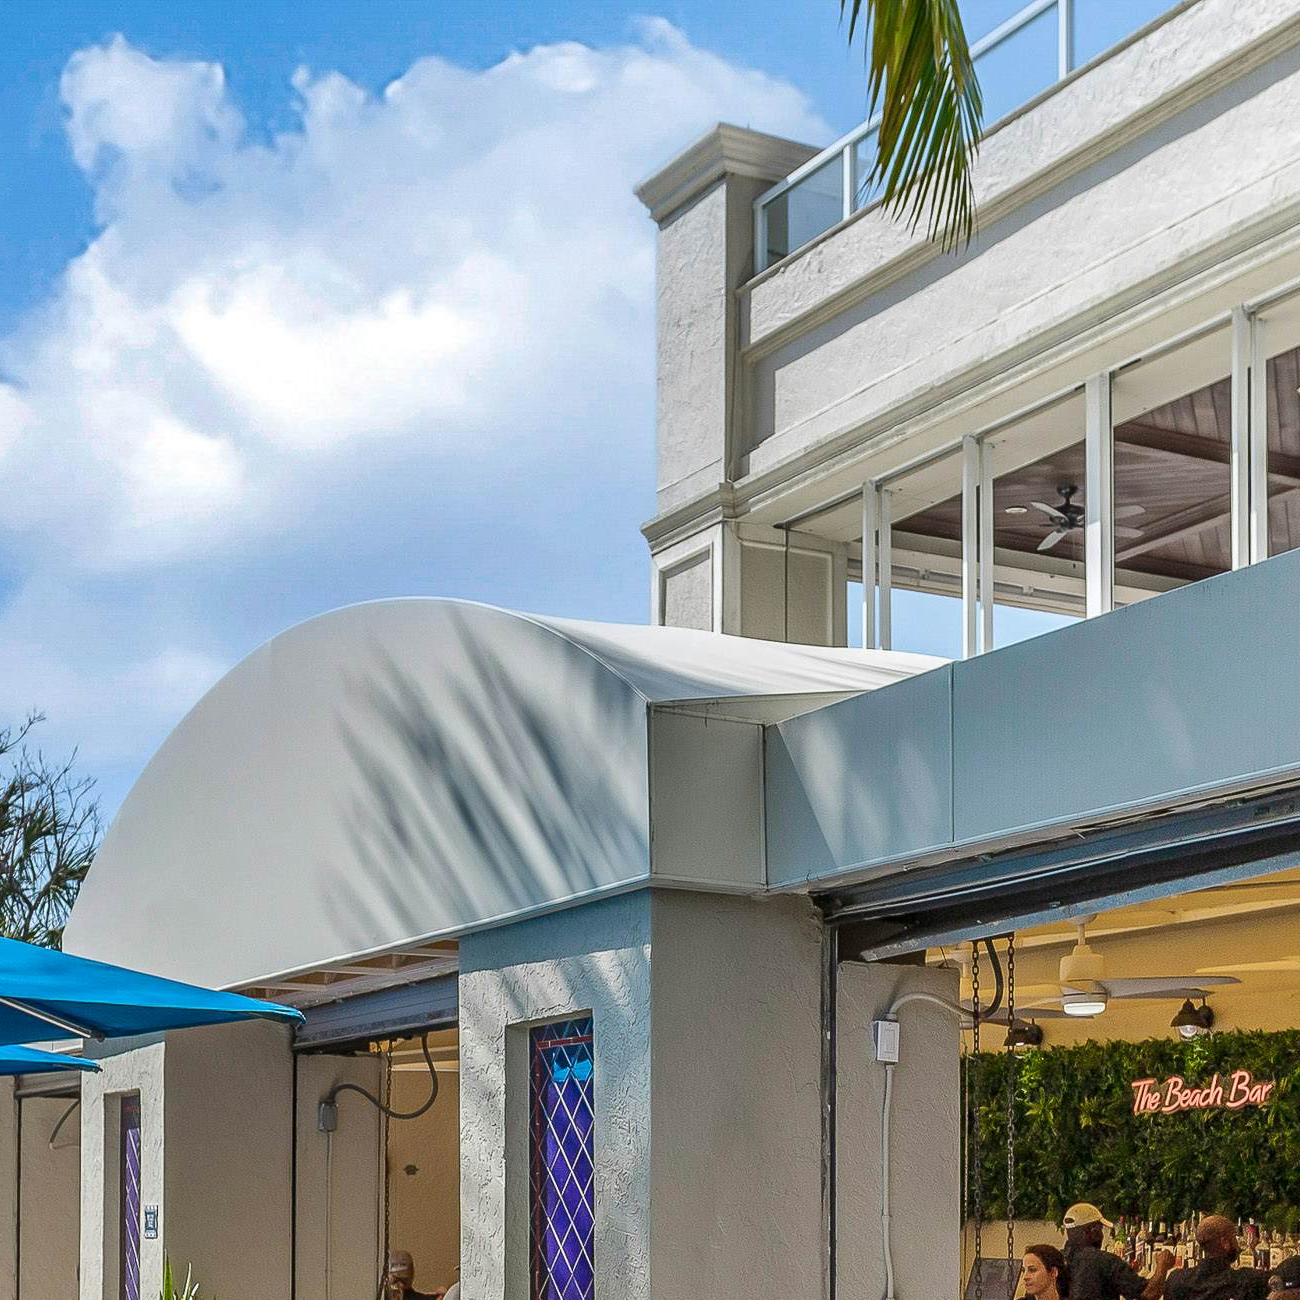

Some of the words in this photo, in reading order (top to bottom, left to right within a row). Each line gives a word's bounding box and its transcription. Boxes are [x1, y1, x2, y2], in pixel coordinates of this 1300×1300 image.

[1131, 1077, 1161, 1115] The
[1161, 1073, 1223, 1114] Beach
[1226, 1069, 1274, 1109] Bar
